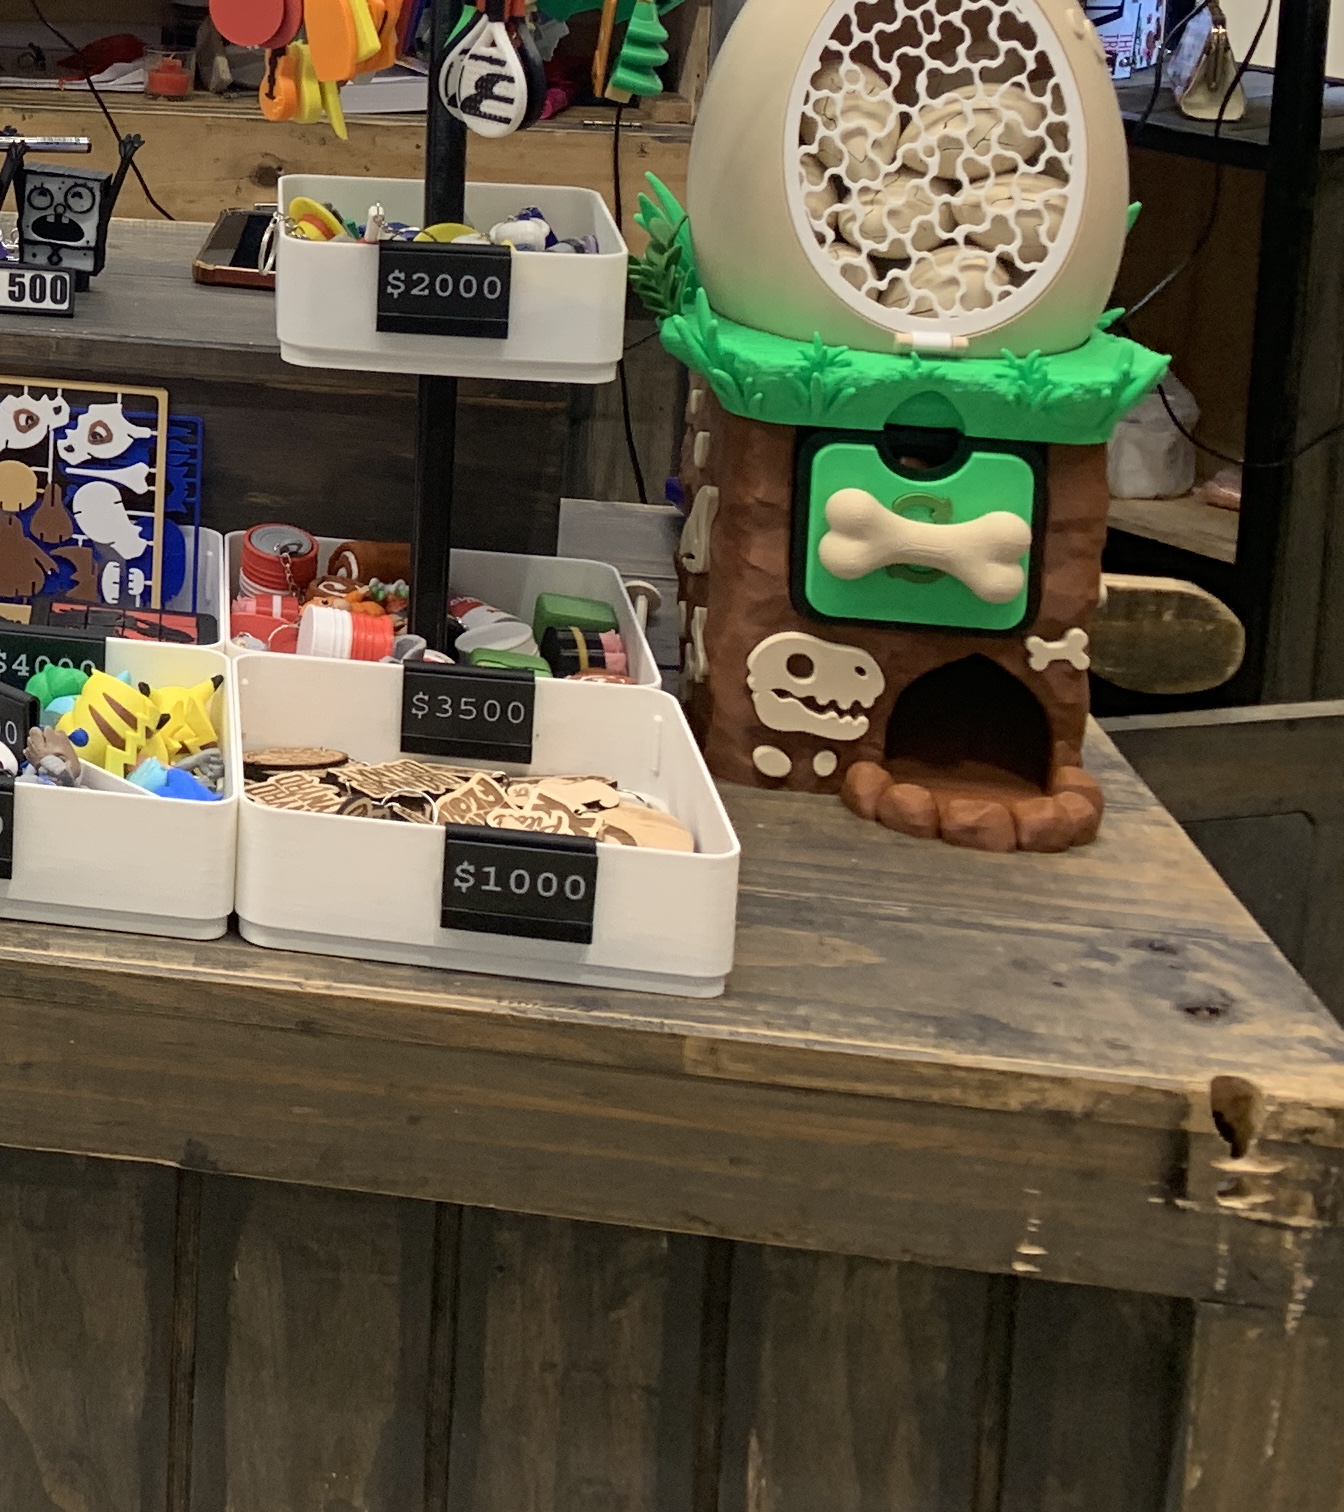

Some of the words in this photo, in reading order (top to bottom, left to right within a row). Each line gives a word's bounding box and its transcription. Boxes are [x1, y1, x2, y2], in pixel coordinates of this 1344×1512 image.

[387, 270, 502, 300] $2000
[411, 691, 526, 724] $3500
[453, 860, 587, 901] $1000
